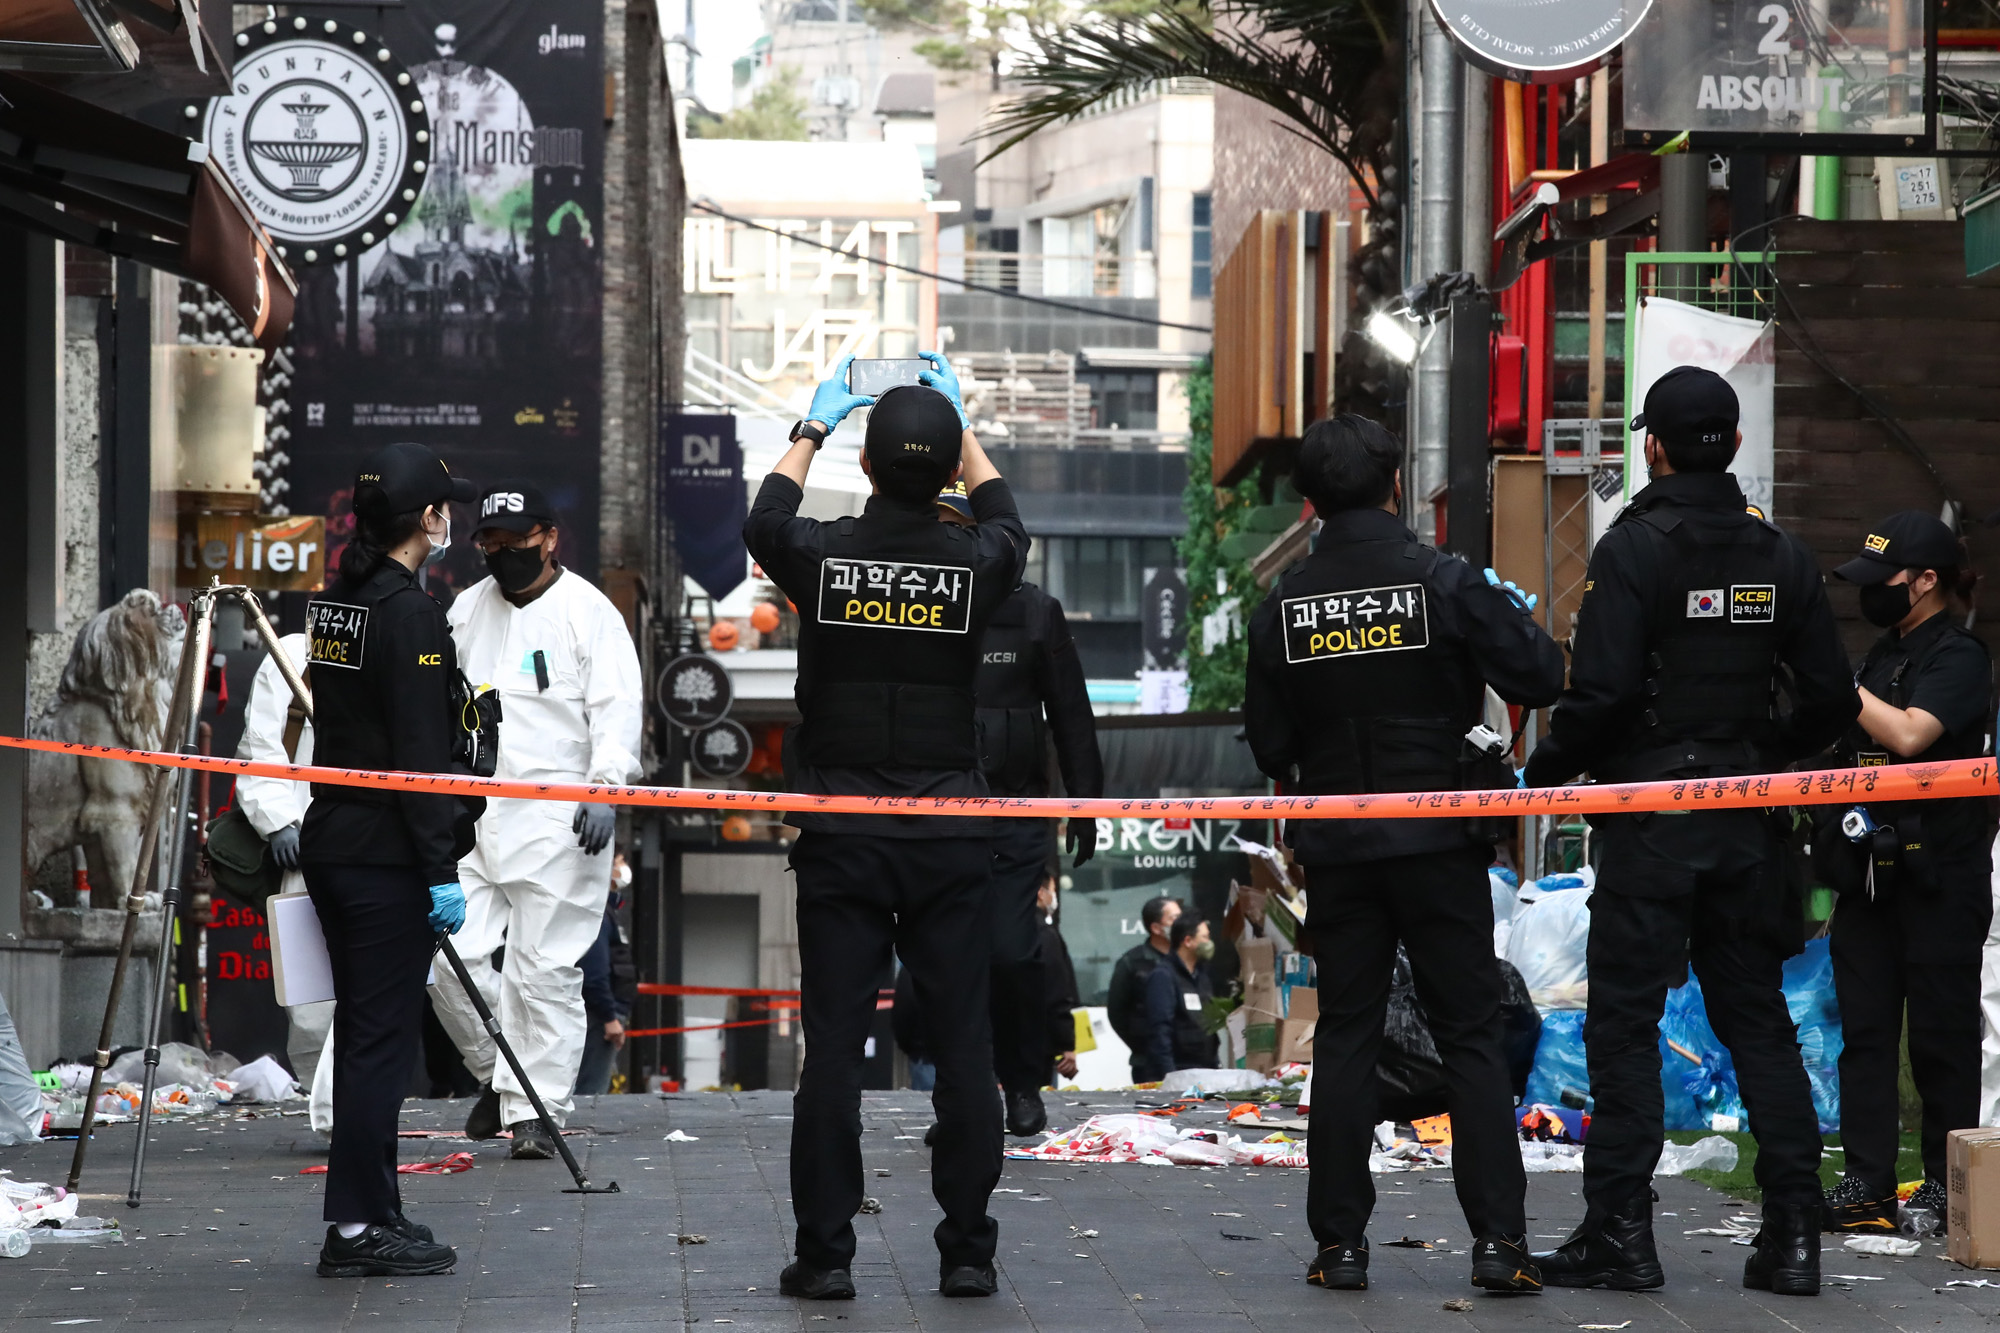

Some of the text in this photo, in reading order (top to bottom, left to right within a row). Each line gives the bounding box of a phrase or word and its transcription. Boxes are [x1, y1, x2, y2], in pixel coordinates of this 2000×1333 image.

[1460, 13, 1490, 42] CLUB
[1758, 4, 1790, 55] 2
[538, 24, 586, 55] glam
[1491, 35, 1534, 56] SOCIAL
[1549, 36, 1589, 56] MUSIC
[223, 57, 388, 121] FOUNTAIN
[1911, 181, 1930, 192] 251
[1915, 192, 1935, 204] 275
[236, 178, 277, 217] CANTEEN
[282, 213, 331, 225] ROOFTOP
[336, 190, 372, 218] LOUNGE
[904, 443, 931, 453] 과학수사
[1702, 433, 1721, 443] CSI
[482, 492, 525, 518] NFS
[830, 565, 962, 602] 과학수사
[1734, 591, 1772, 602] KCSI
[845, 599, 944, 627] POLICE
[1292, 590, 1416, 629] 과학수사
[1734, 605, 1772, 615] 과학수사
[1310, 624, 1403, 655] POLICE
[983, 651, 1017, 665] KCSI
[1669, 770, 1880, 801] 경찰통제선 경찰서장
[1407, 788, 1580, 809] 이선을 넘지마시오.
[1134, 855, 1198, 869] LOUNGE
